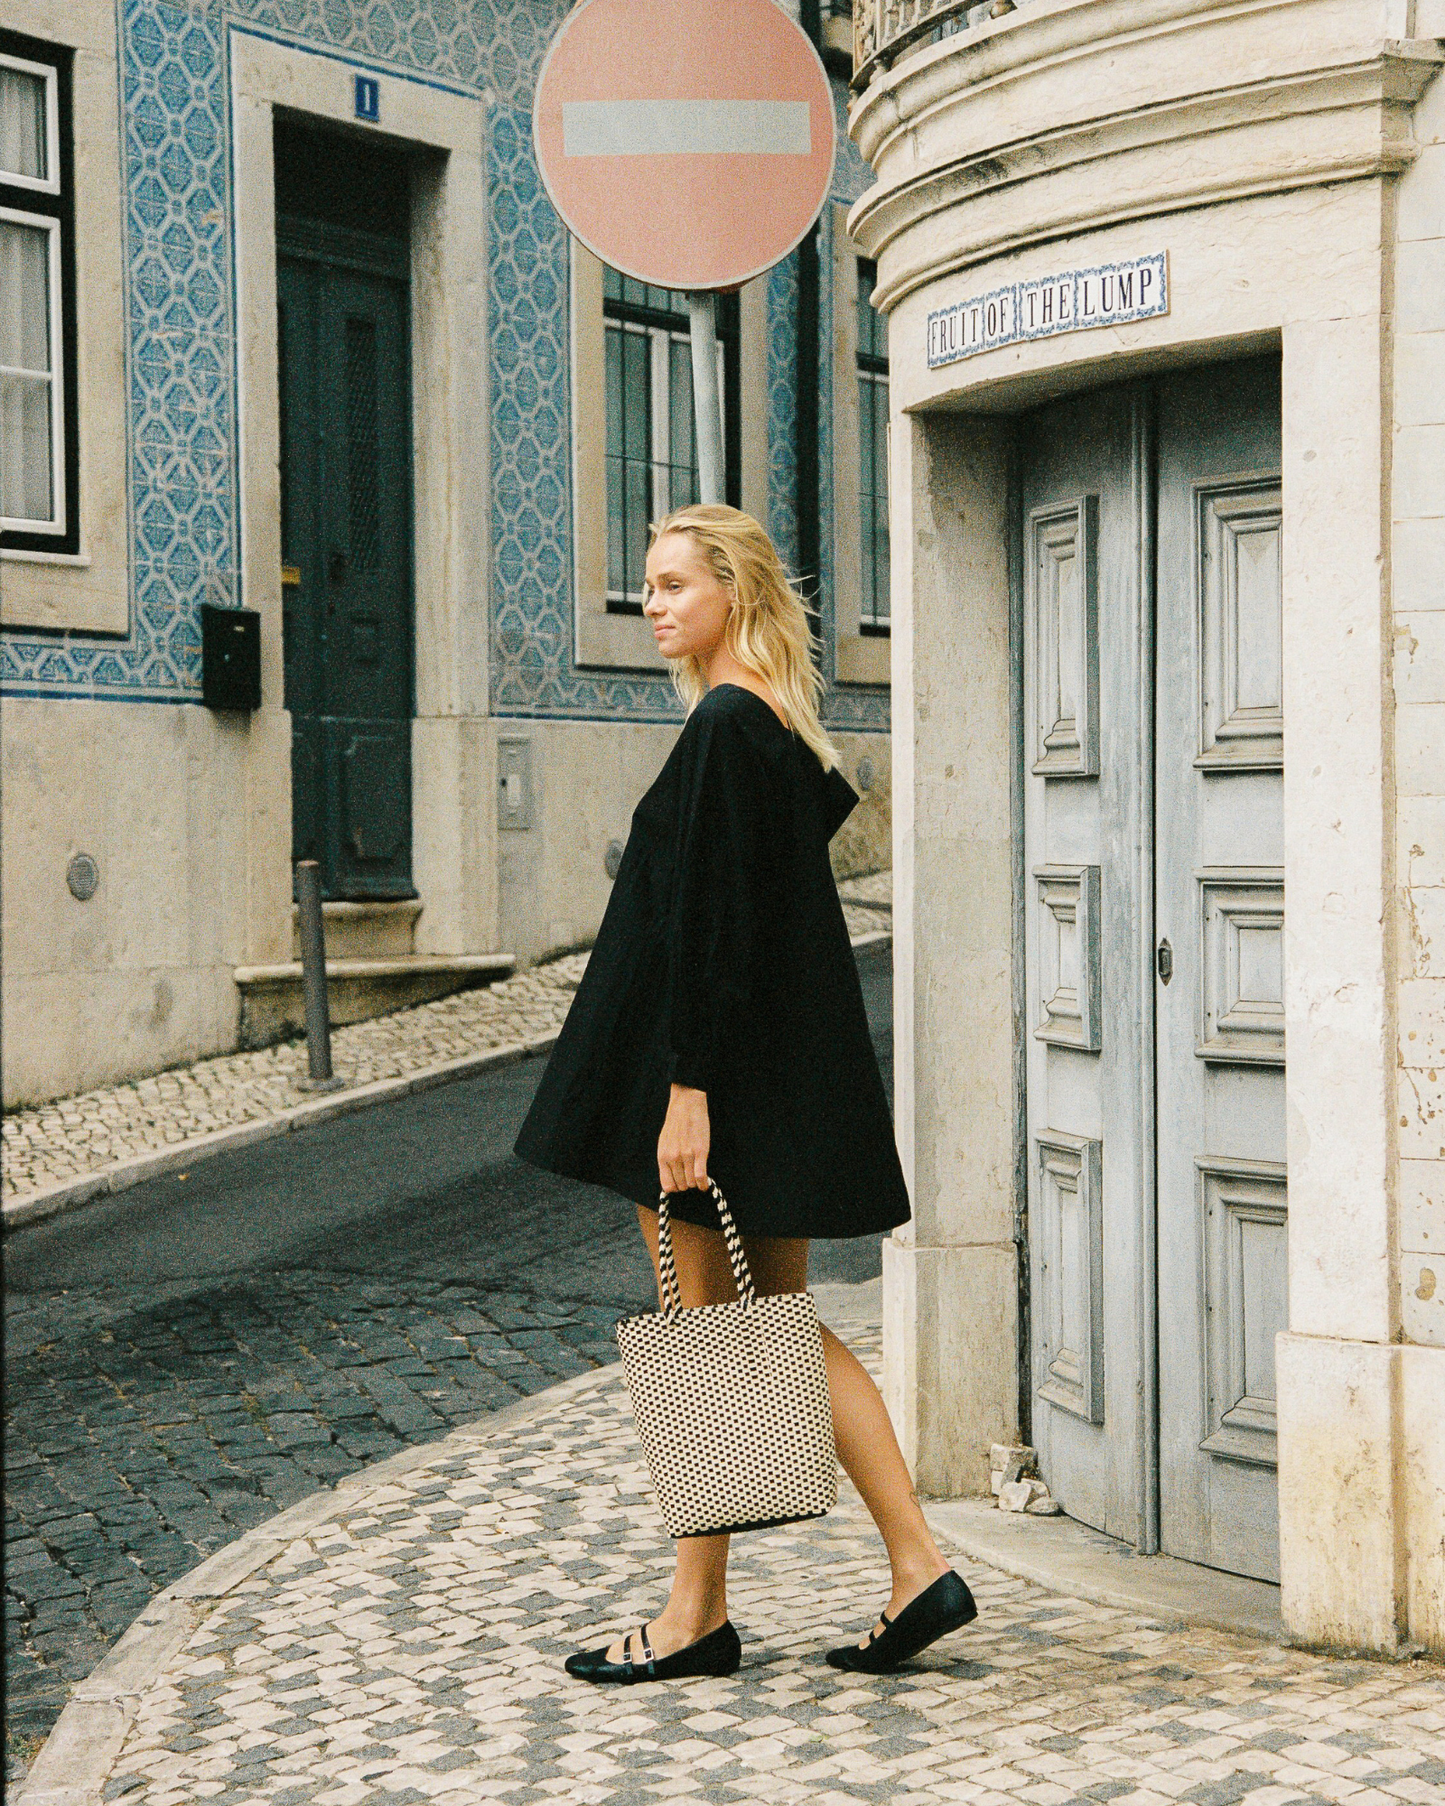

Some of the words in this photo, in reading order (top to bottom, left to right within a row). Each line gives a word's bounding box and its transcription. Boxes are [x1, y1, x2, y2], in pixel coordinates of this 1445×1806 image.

[931, 309, 979, 356] FRUIT
[987, 297, 1009, 337] OF
[1027, 283, 1071, 328] THE
[1083, 268, 1153, 316] LUMP
